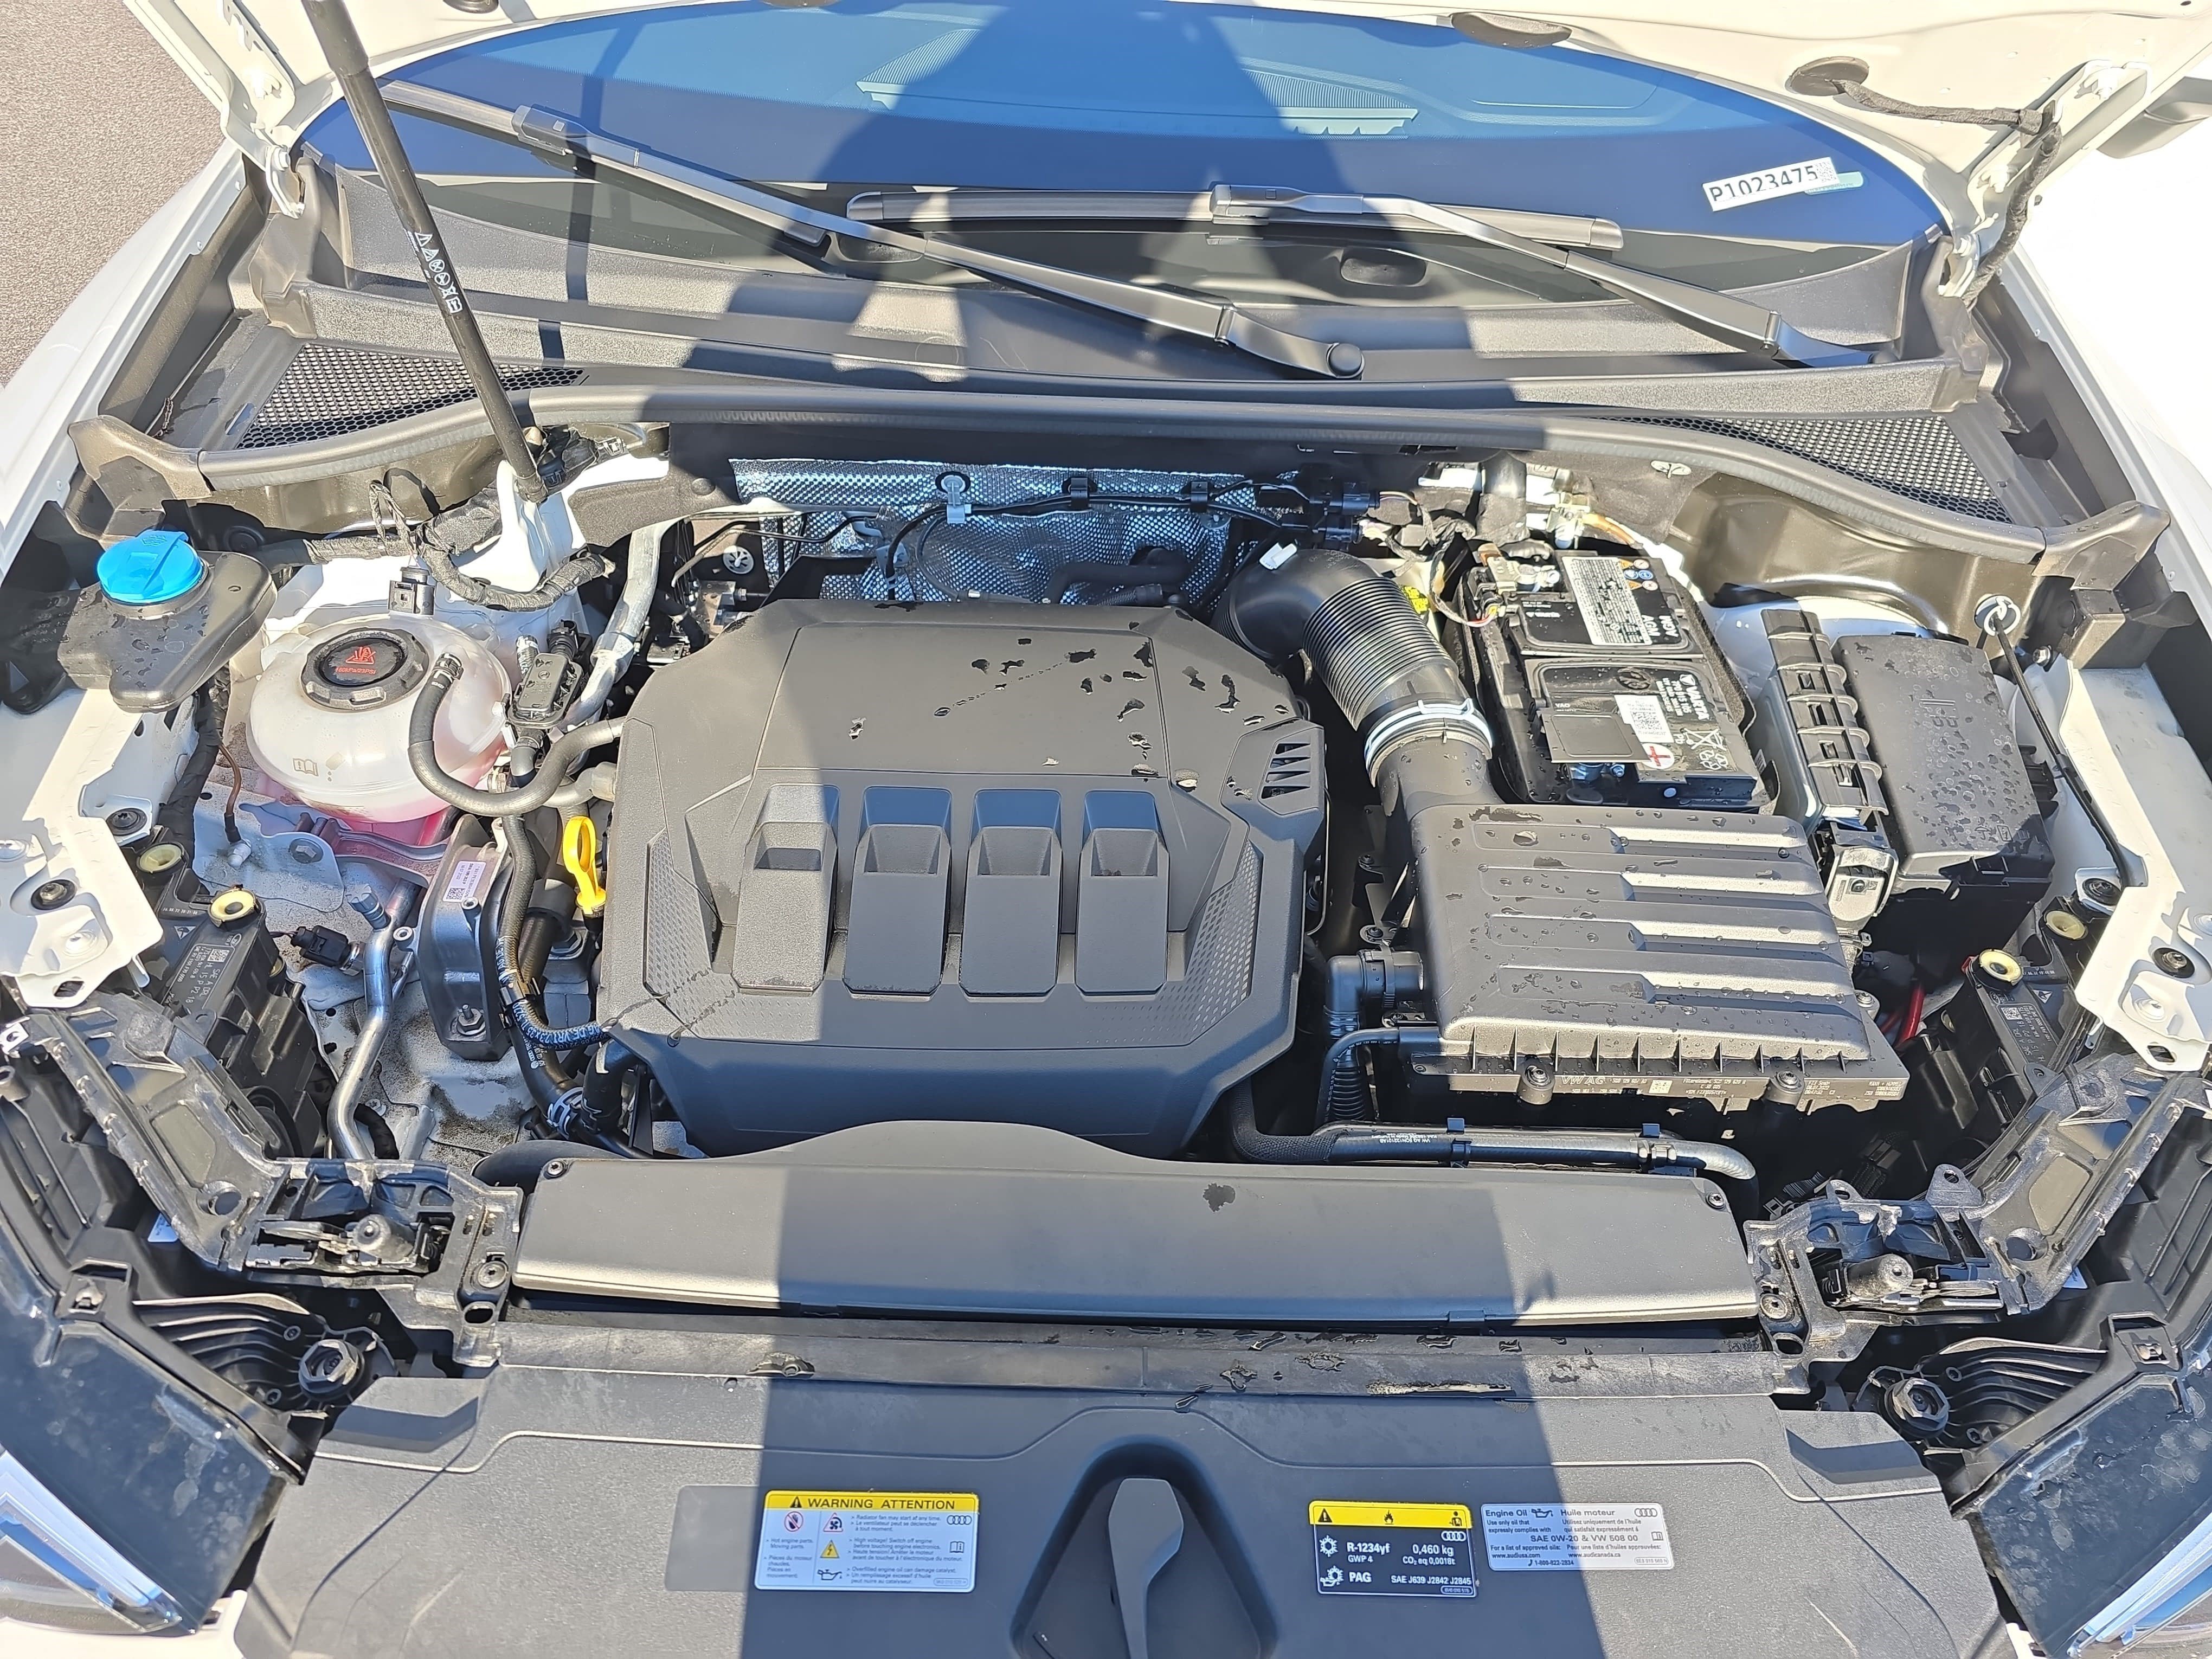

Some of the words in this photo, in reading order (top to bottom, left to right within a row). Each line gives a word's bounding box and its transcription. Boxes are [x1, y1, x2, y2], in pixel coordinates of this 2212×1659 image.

[1709, 165, 1818, 201] P1023475
[1641, 614, 1661, 636] AGM
[1659, 615, 1679, 637] AGM
[1686, 686, 1710, 721] VARTA
[1673, 734, 1686, 744] Pb
[496, 947, 504, 959] DE
[497, 959, 505, 970] AG
[571, 1027, 586, 1040] DE
[1561, 1076, 1584, 1084] VW
[1585, 1076, 1606, 1084] AG
[808, 1498, 873, 1508] WARNING
[881, 1500, 955, 1509] ATTENTION
[1347, 1542, 1391, 1555] R-1234yf
[1412, 1544, 1440, 1555] 0,460
[1442, 1545, 1455, 1557] kg
[1348, 1554, 1367, 1562] GWP
[1429, 1557, 1456, 1565] 0,0018t
[1349, 1572, 1372, 1583] PAG
[1391, 1575, 1407, 1584] SAE
[1408, 1576, 1426, 1584] J639
[1427, 1576, 1449, 1584] J2842
[1450, 1577, 1472, 1585] J2845
